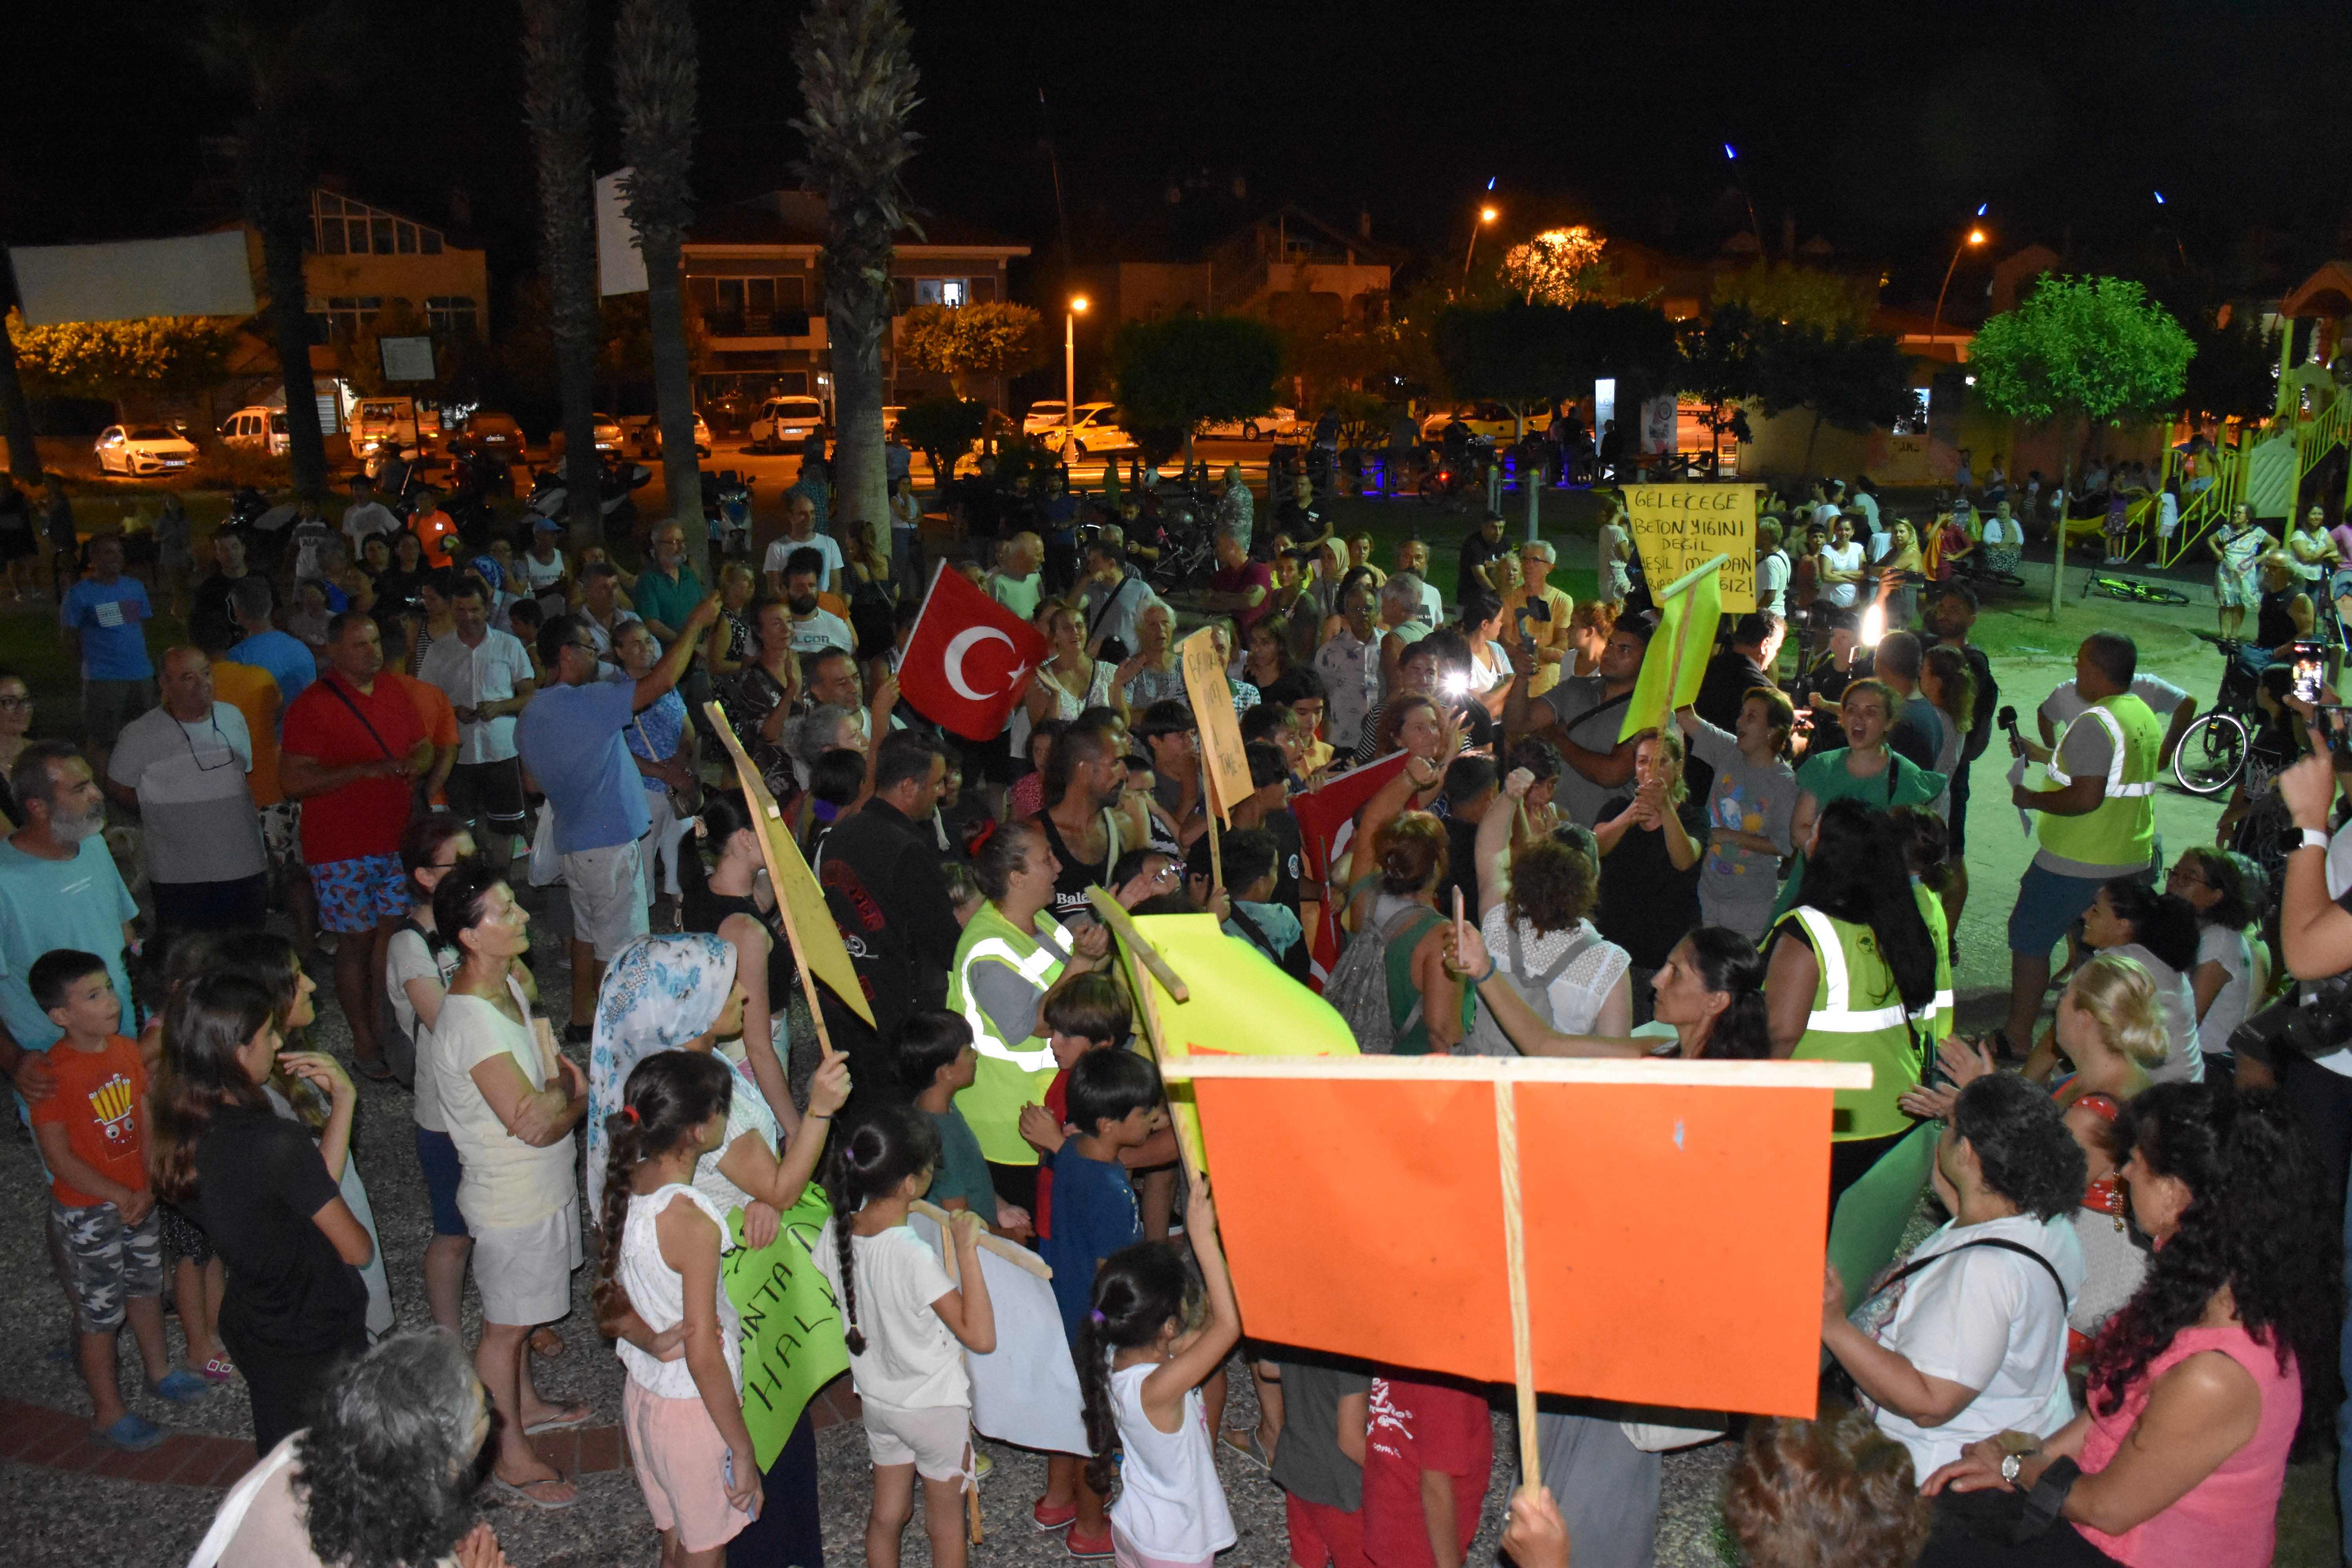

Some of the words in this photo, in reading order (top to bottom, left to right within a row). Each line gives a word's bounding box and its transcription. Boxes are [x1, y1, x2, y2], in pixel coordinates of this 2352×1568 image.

[1634, 517, 1684, 535] BETON
[1690, 517, 1743, 537] YIĞINI
[1662, 537, 1713, 552] DEĞİL
